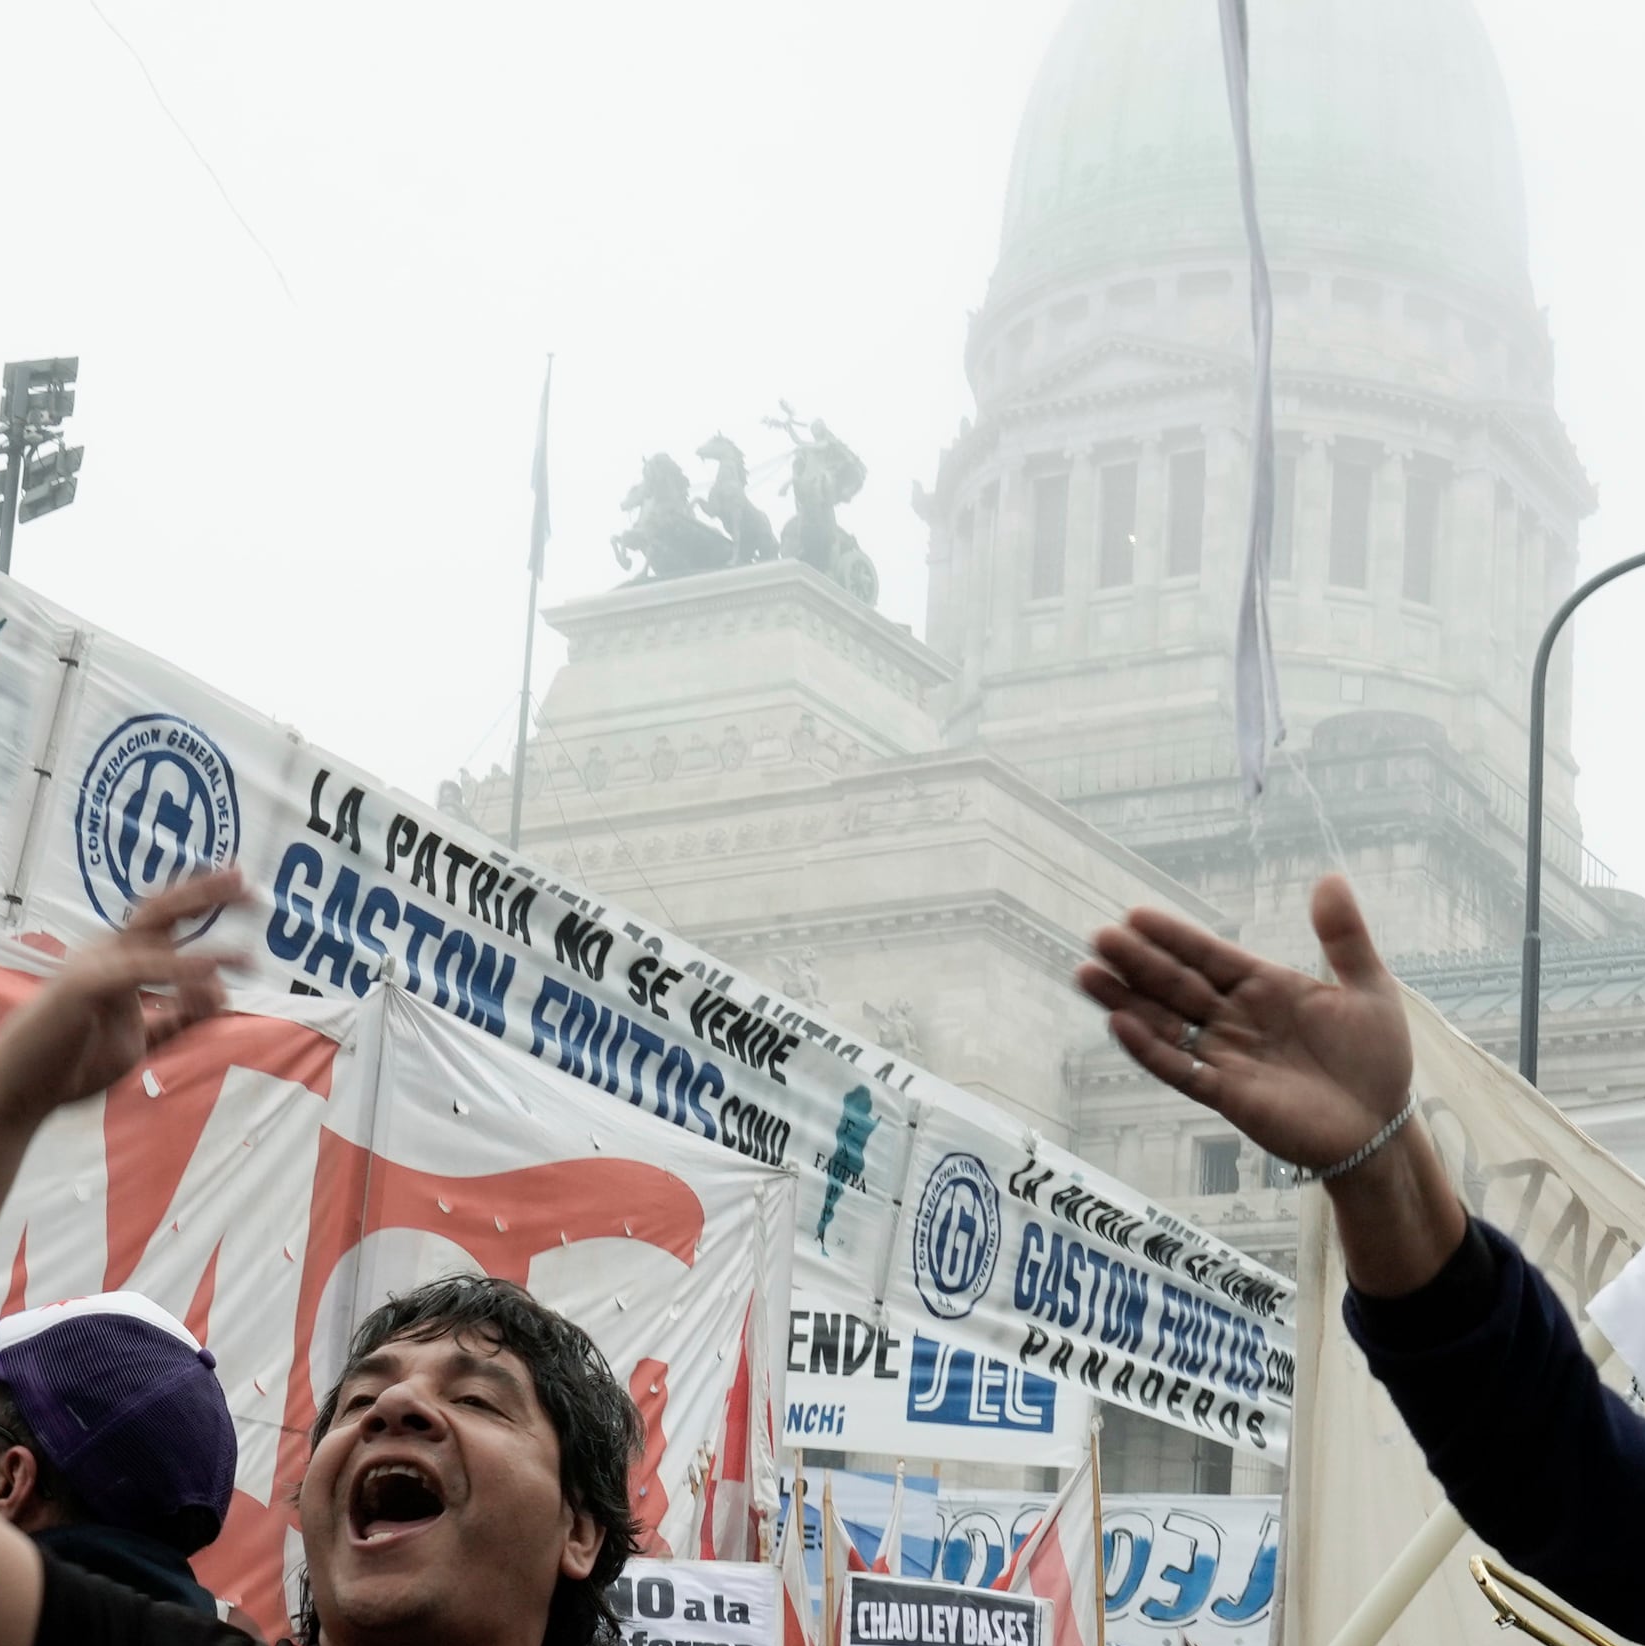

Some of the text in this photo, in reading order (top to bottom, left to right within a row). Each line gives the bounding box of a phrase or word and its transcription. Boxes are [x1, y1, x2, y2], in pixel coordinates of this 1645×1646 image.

[88, 728, 161, 866] CONFEDERACION
[167, 729, 222, 794] GENERAL
[216, 796, 229, 834] DEL
[306, 768, 365, 854] LA
[554, 911, 614, 982] NO
[626, 955, 684, 1020] SE
[689, 989, 800, 1086] VENDE
[265, 842, 517, 1039] GASTON
[530, 975, 725, 1142] FRUTOS
[1009, 1159, 1054, 1207] LA
[1144, 1233, 1183, 1271] NO
[786, 1311, 900, 1380] ENDE
[1014, 1221, 1296, 1400] GASTON FRUTOS CON
[1019, 1322, 1267, 1449] PANADEROS
[607, 1577, 751, 1625] NO a la
[857, 1601, 919, 1641] CHAU
[921, 1604, 960, 1644] LEY
